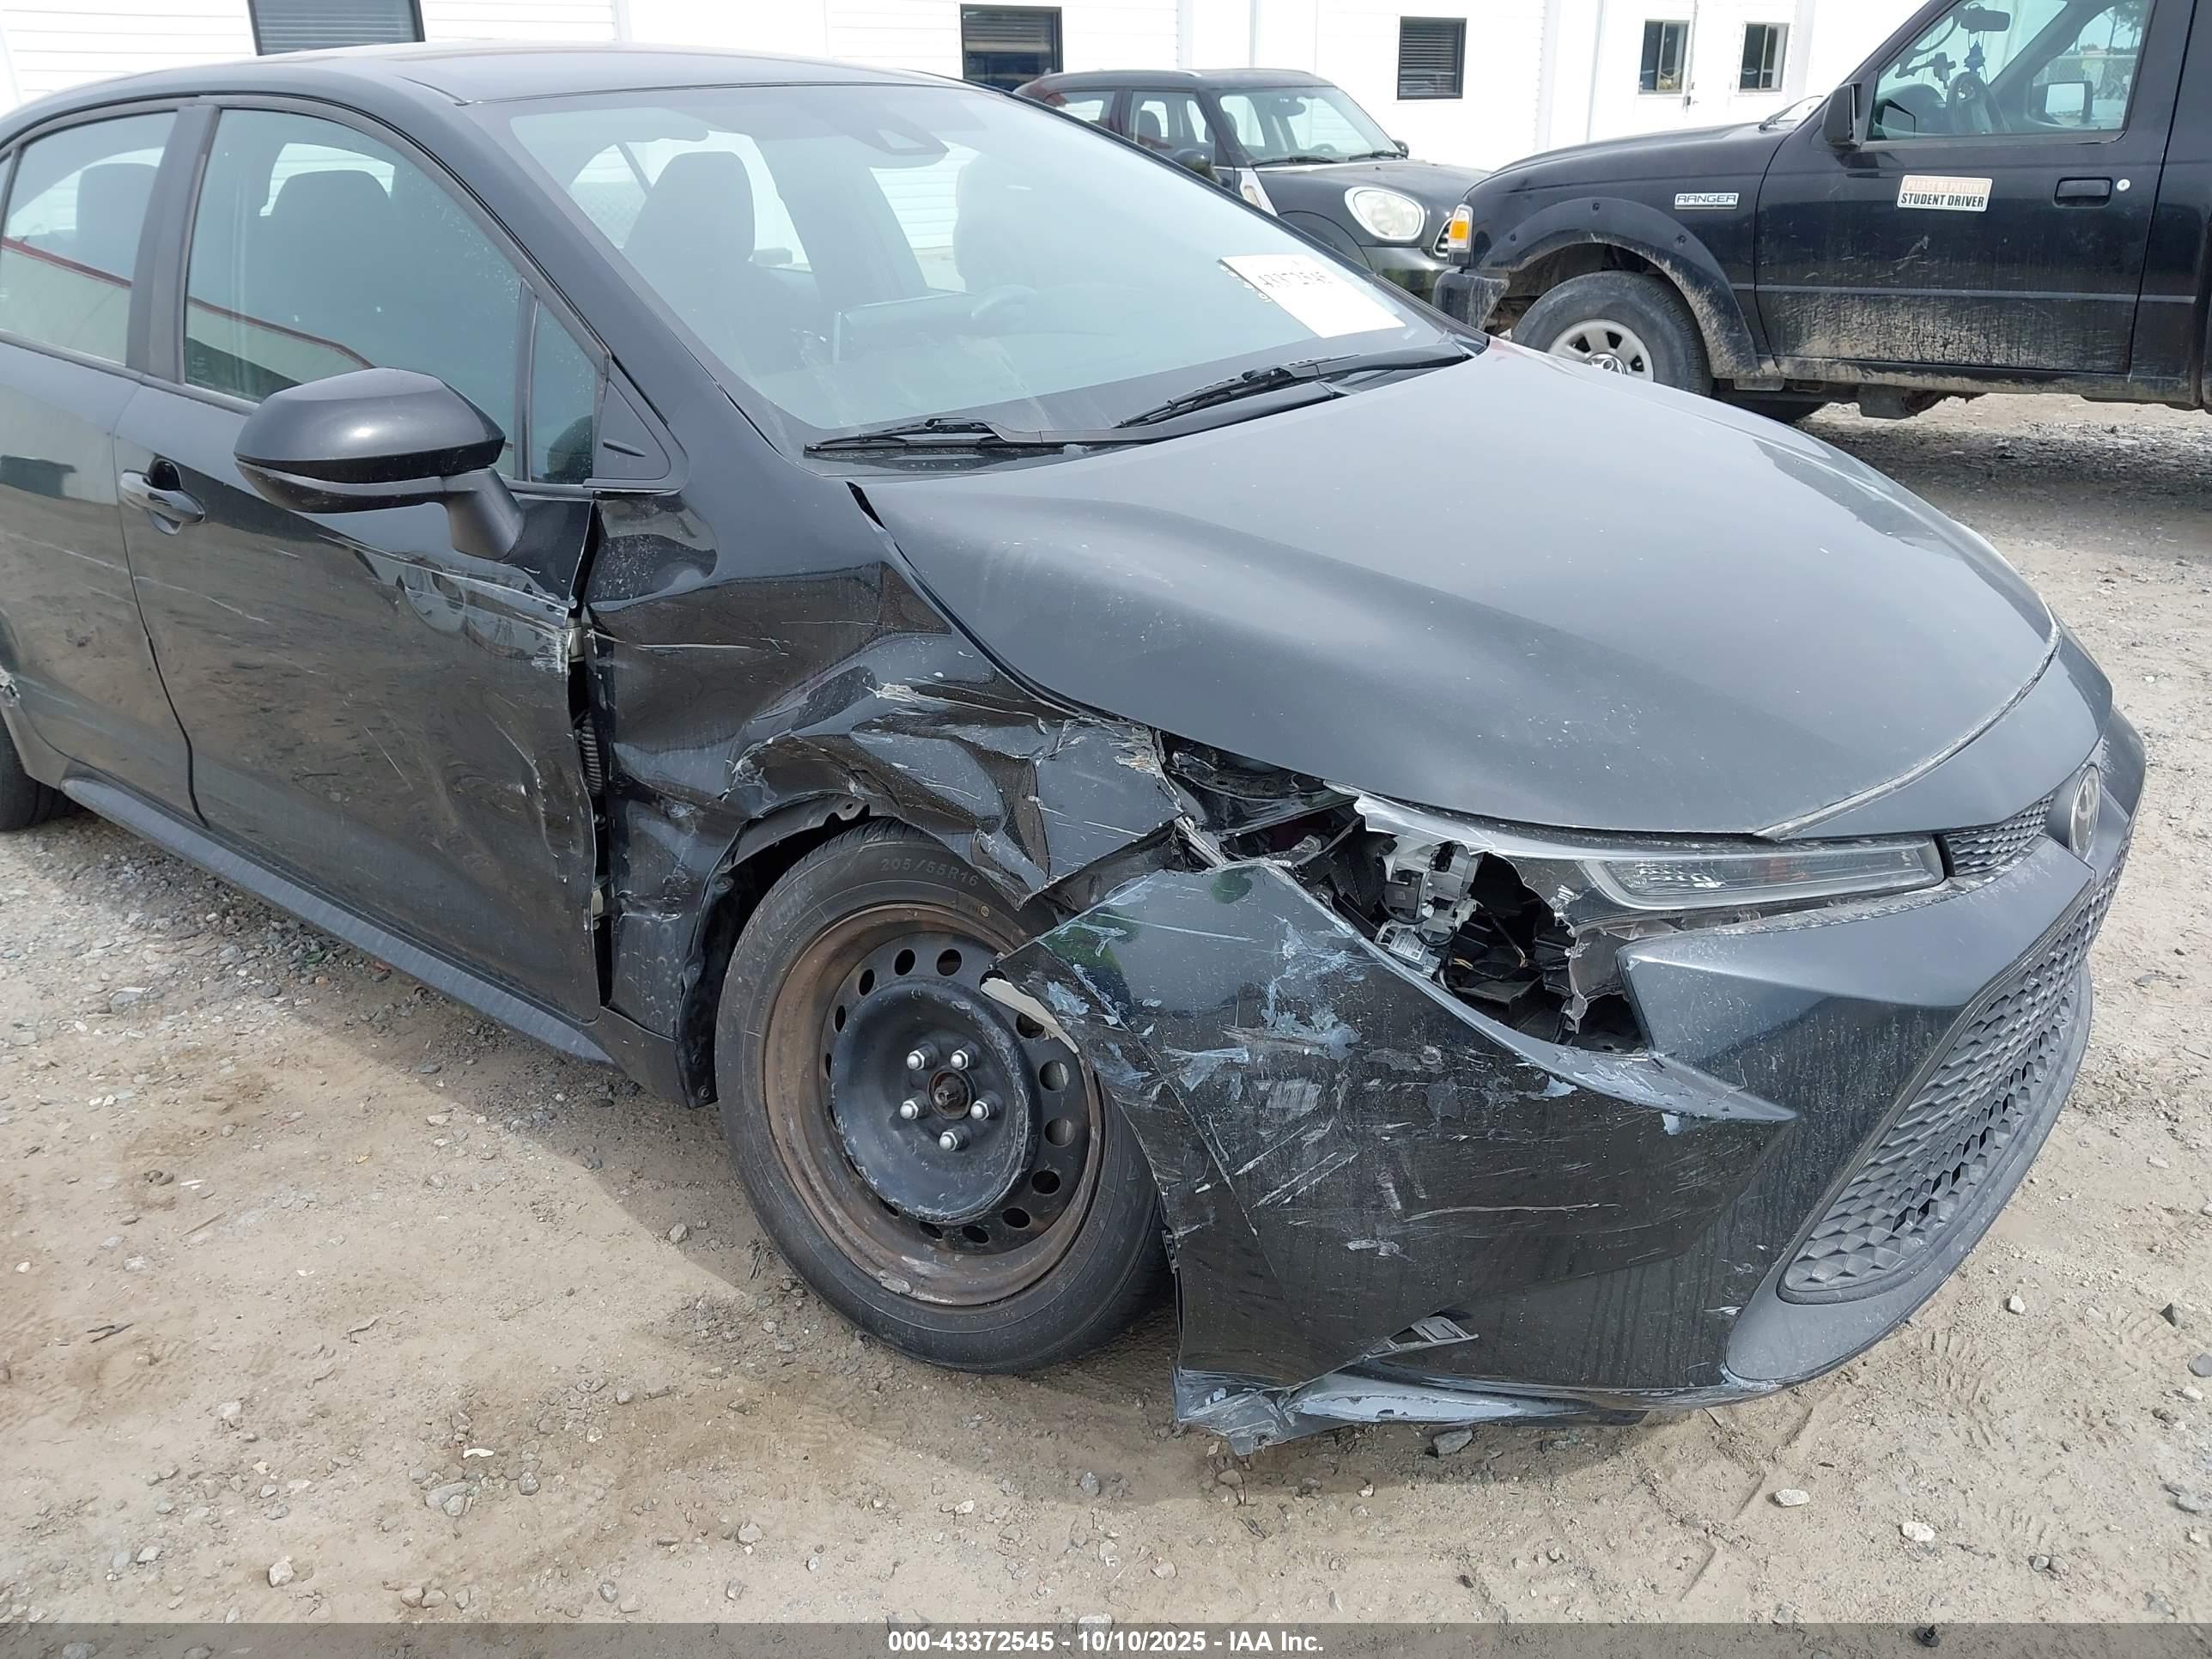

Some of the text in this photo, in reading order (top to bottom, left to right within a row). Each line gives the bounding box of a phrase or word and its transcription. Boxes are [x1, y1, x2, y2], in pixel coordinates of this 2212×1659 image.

[1677, 194, 1736, 204] RANGER
[1901, 192, 1984, 208] STUDENT DRIVER
